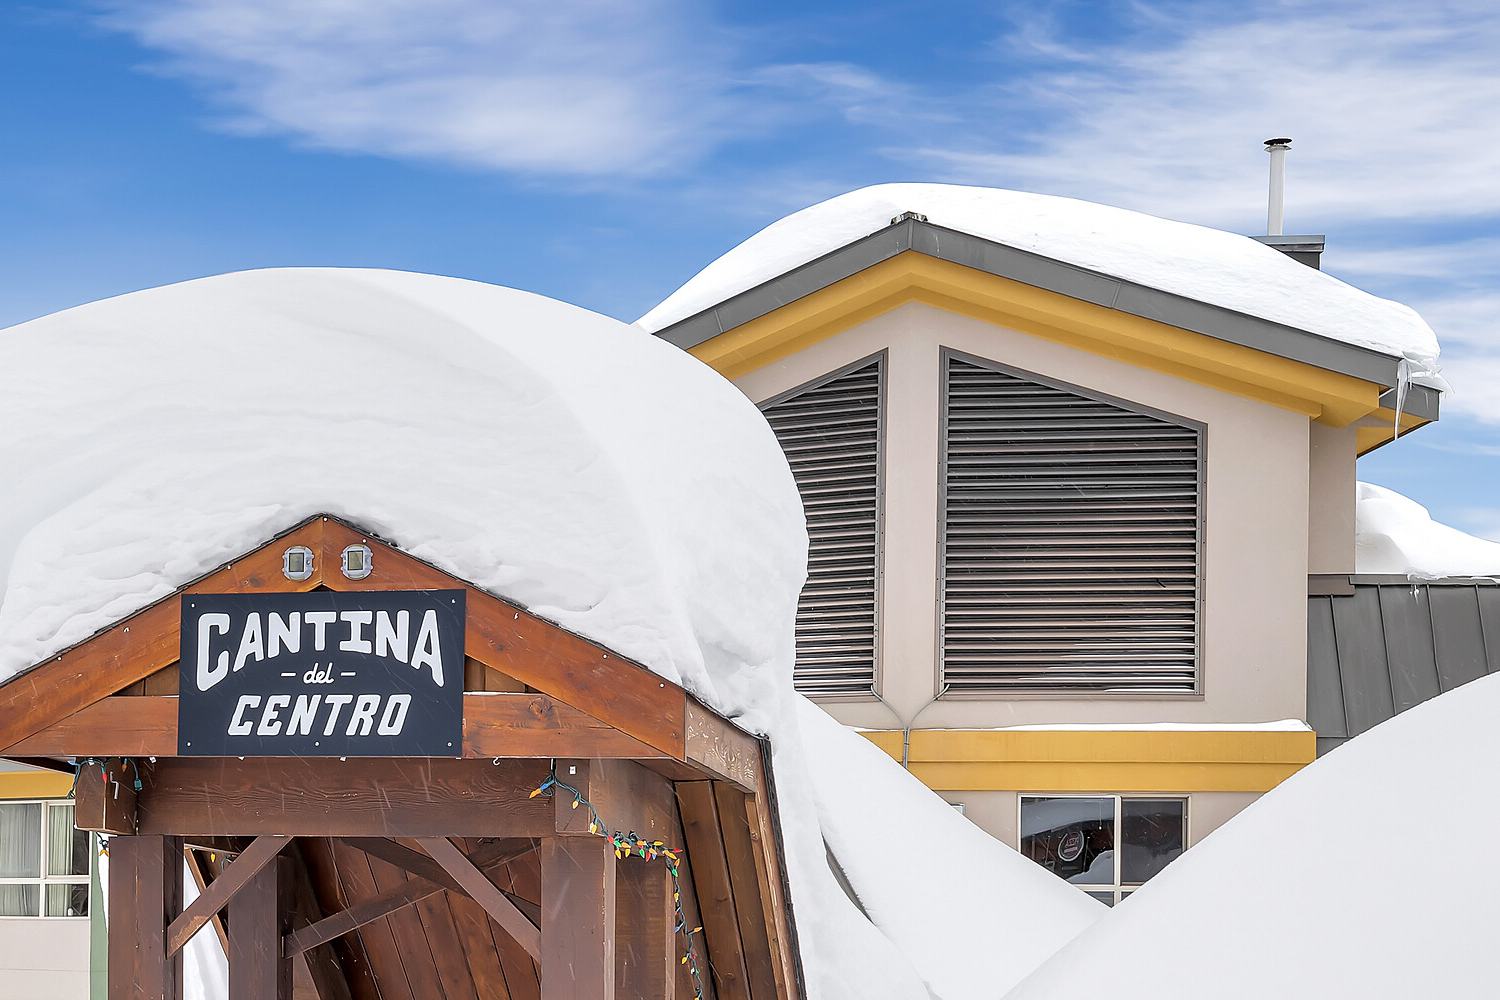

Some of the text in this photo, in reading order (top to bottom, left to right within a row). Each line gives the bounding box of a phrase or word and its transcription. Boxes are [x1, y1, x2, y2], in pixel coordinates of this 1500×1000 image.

[196, 609, 445, 692] CANTINA
[304, 663, 334, 683] del
[228, 694, 411, 735] CENTRO
